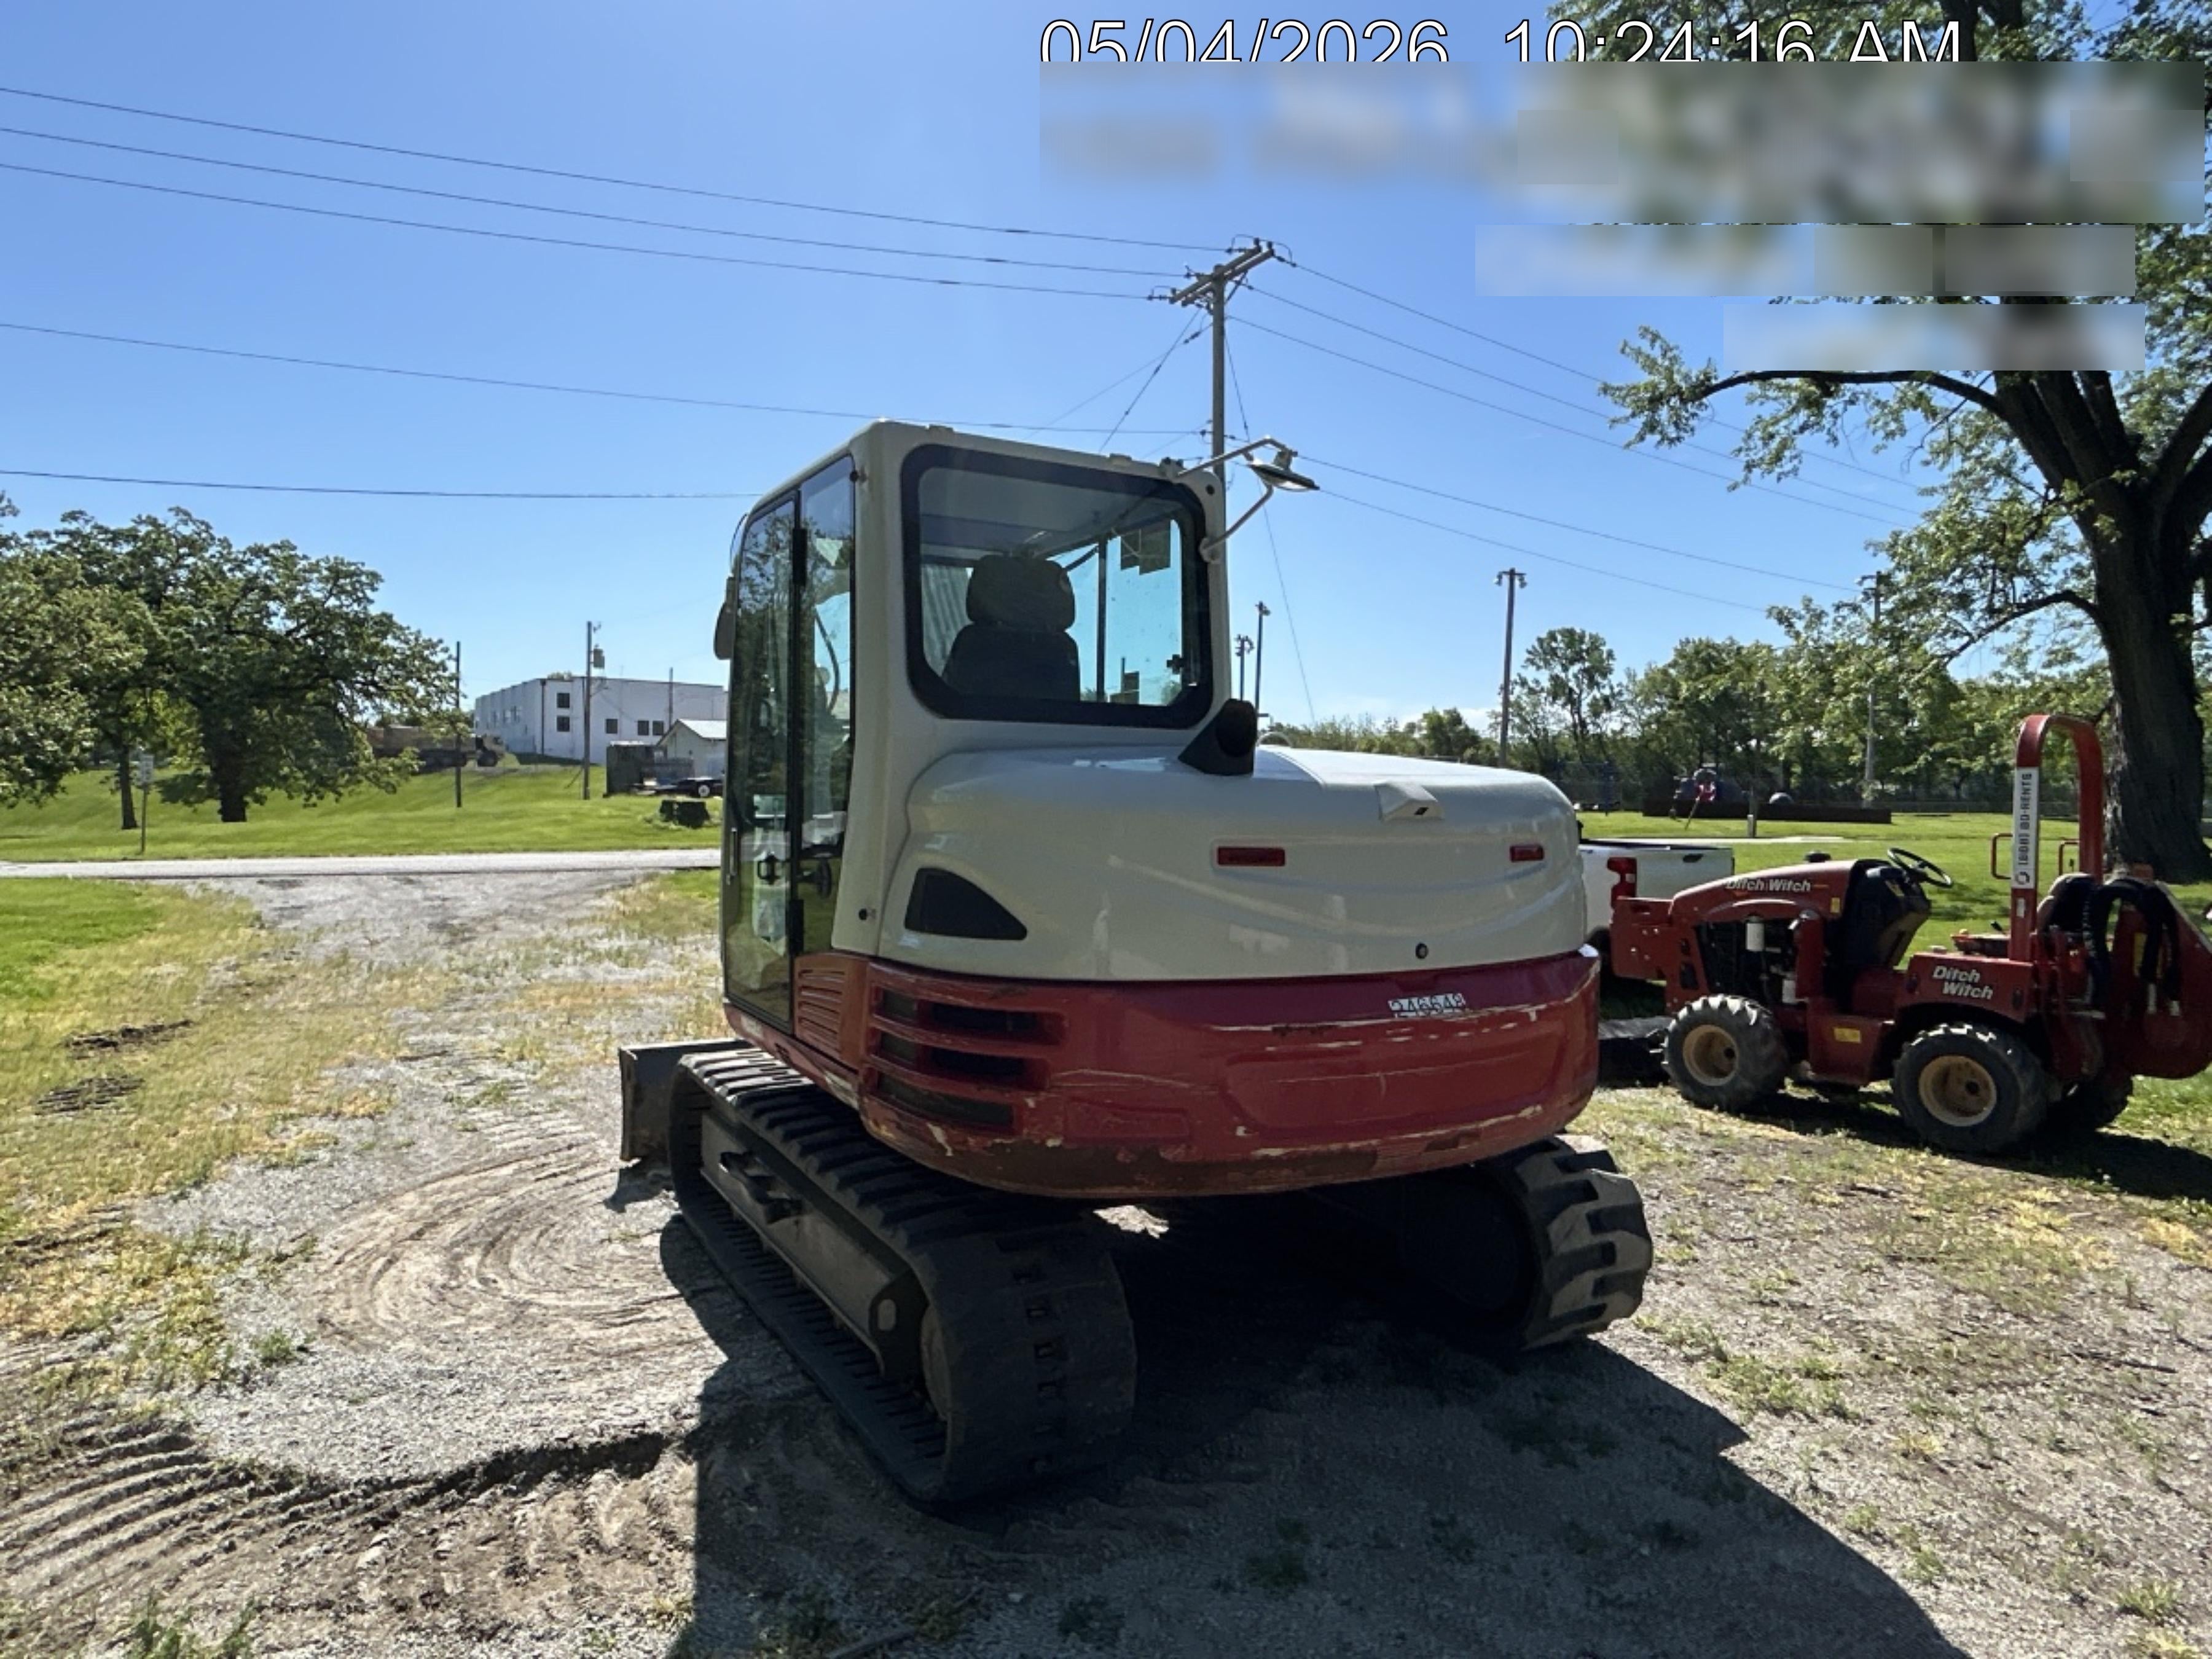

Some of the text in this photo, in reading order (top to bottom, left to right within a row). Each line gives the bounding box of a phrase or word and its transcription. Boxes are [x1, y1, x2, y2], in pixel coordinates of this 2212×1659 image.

[1725, 877, 1811, 892] Ditch Witch
[1932, 965, 1980, 982] Ditch
[1942, 981, 1994, 1000] Witch
